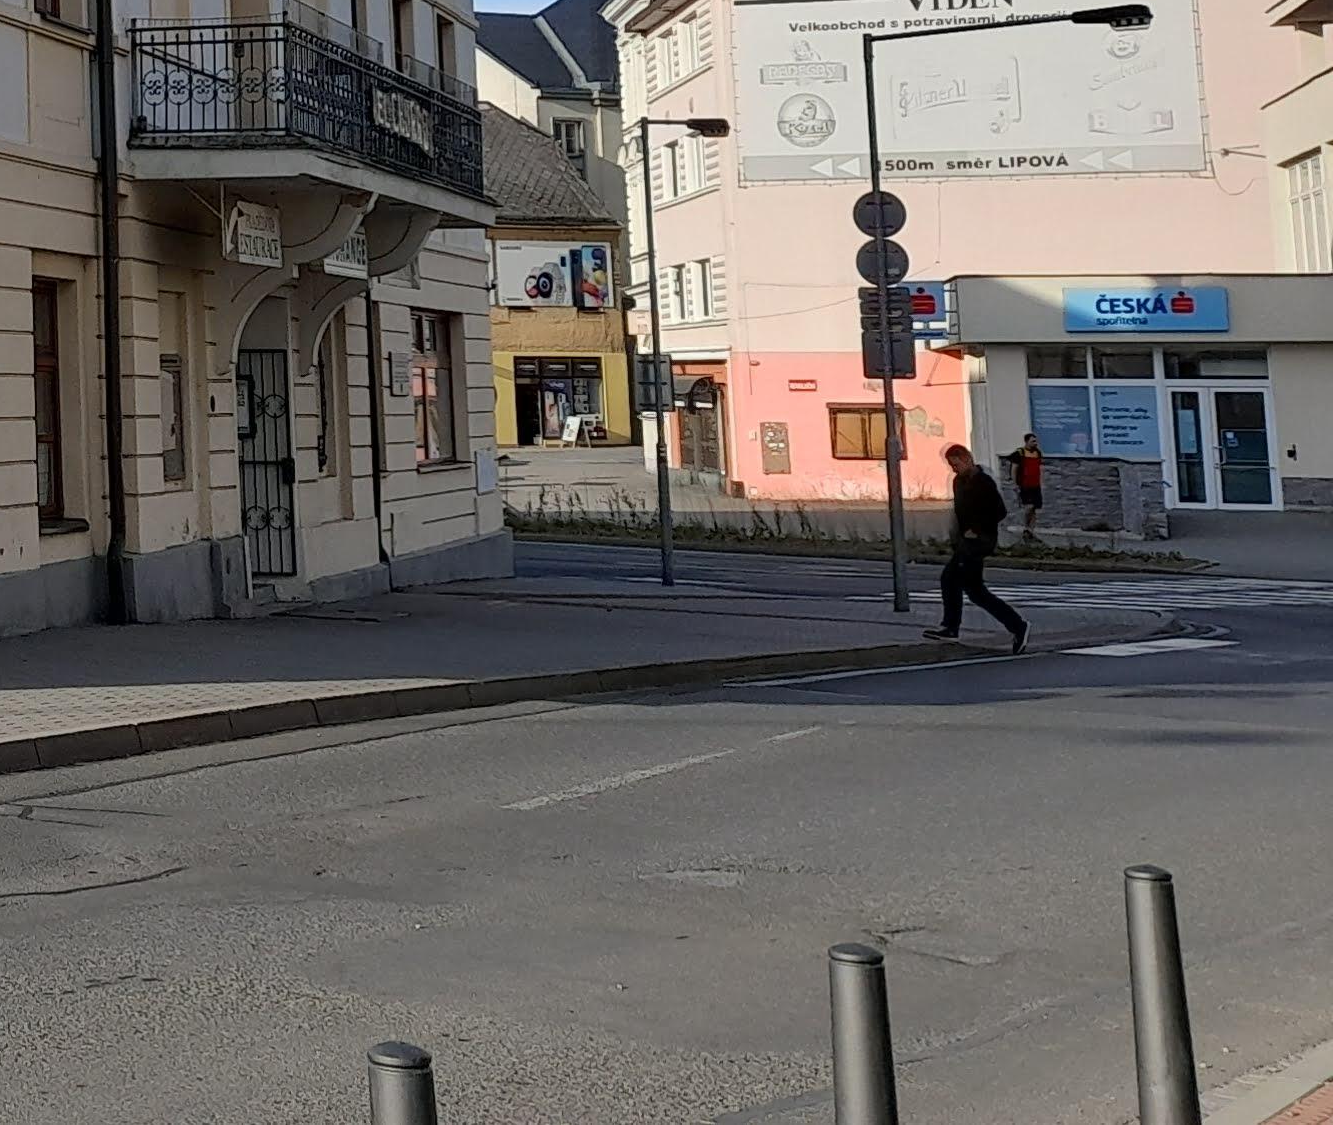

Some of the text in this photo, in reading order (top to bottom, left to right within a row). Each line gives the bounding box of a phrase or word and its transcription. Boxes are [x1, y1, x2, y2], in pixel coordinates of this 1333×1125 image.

[789, 19, 884, 33] Velkoobchod
[890, 20, 899, 29] s
[946, 158, 993, 170] směr
[998, 153, 1070, 168] LIPOVÁ
[1095, 293, 1168, 314] ČESKÁ
